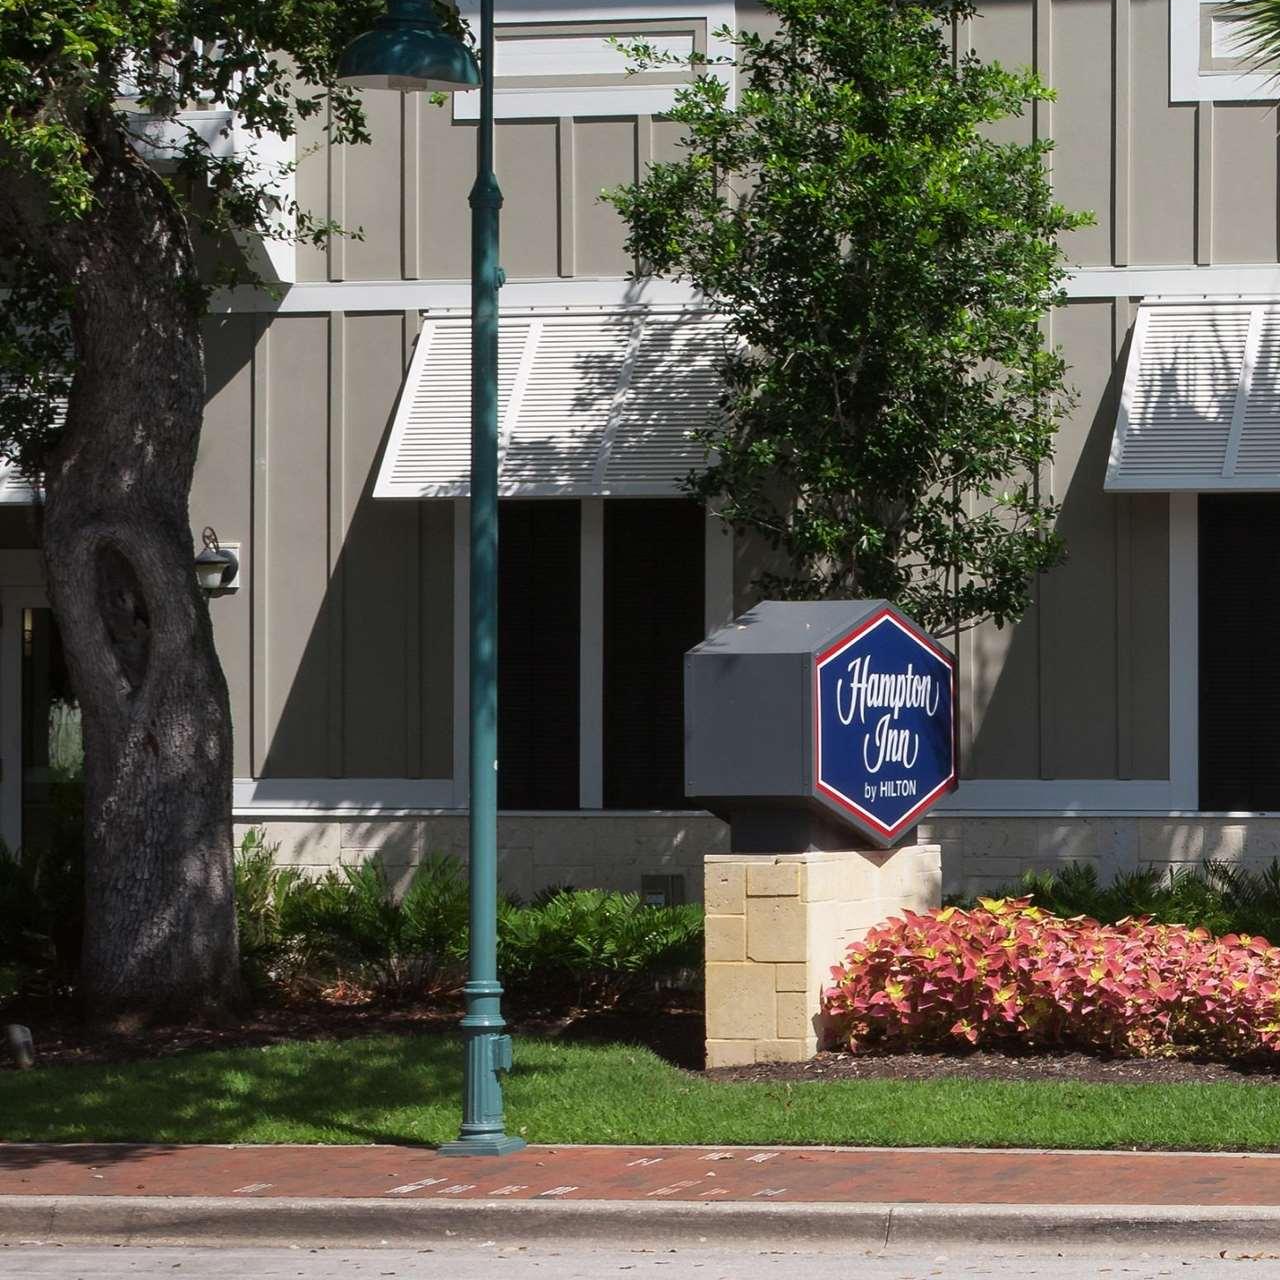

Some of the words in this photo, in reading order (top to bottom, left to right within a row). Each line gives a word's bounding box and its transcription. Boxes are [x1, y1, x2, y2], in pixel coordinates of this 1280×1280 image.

[837, 654, 939, 725] Hampton
[864, 714, 918, 773] Inn
[864, 781, 877, 802] by
[880, 780, 917, 798] HILTON
